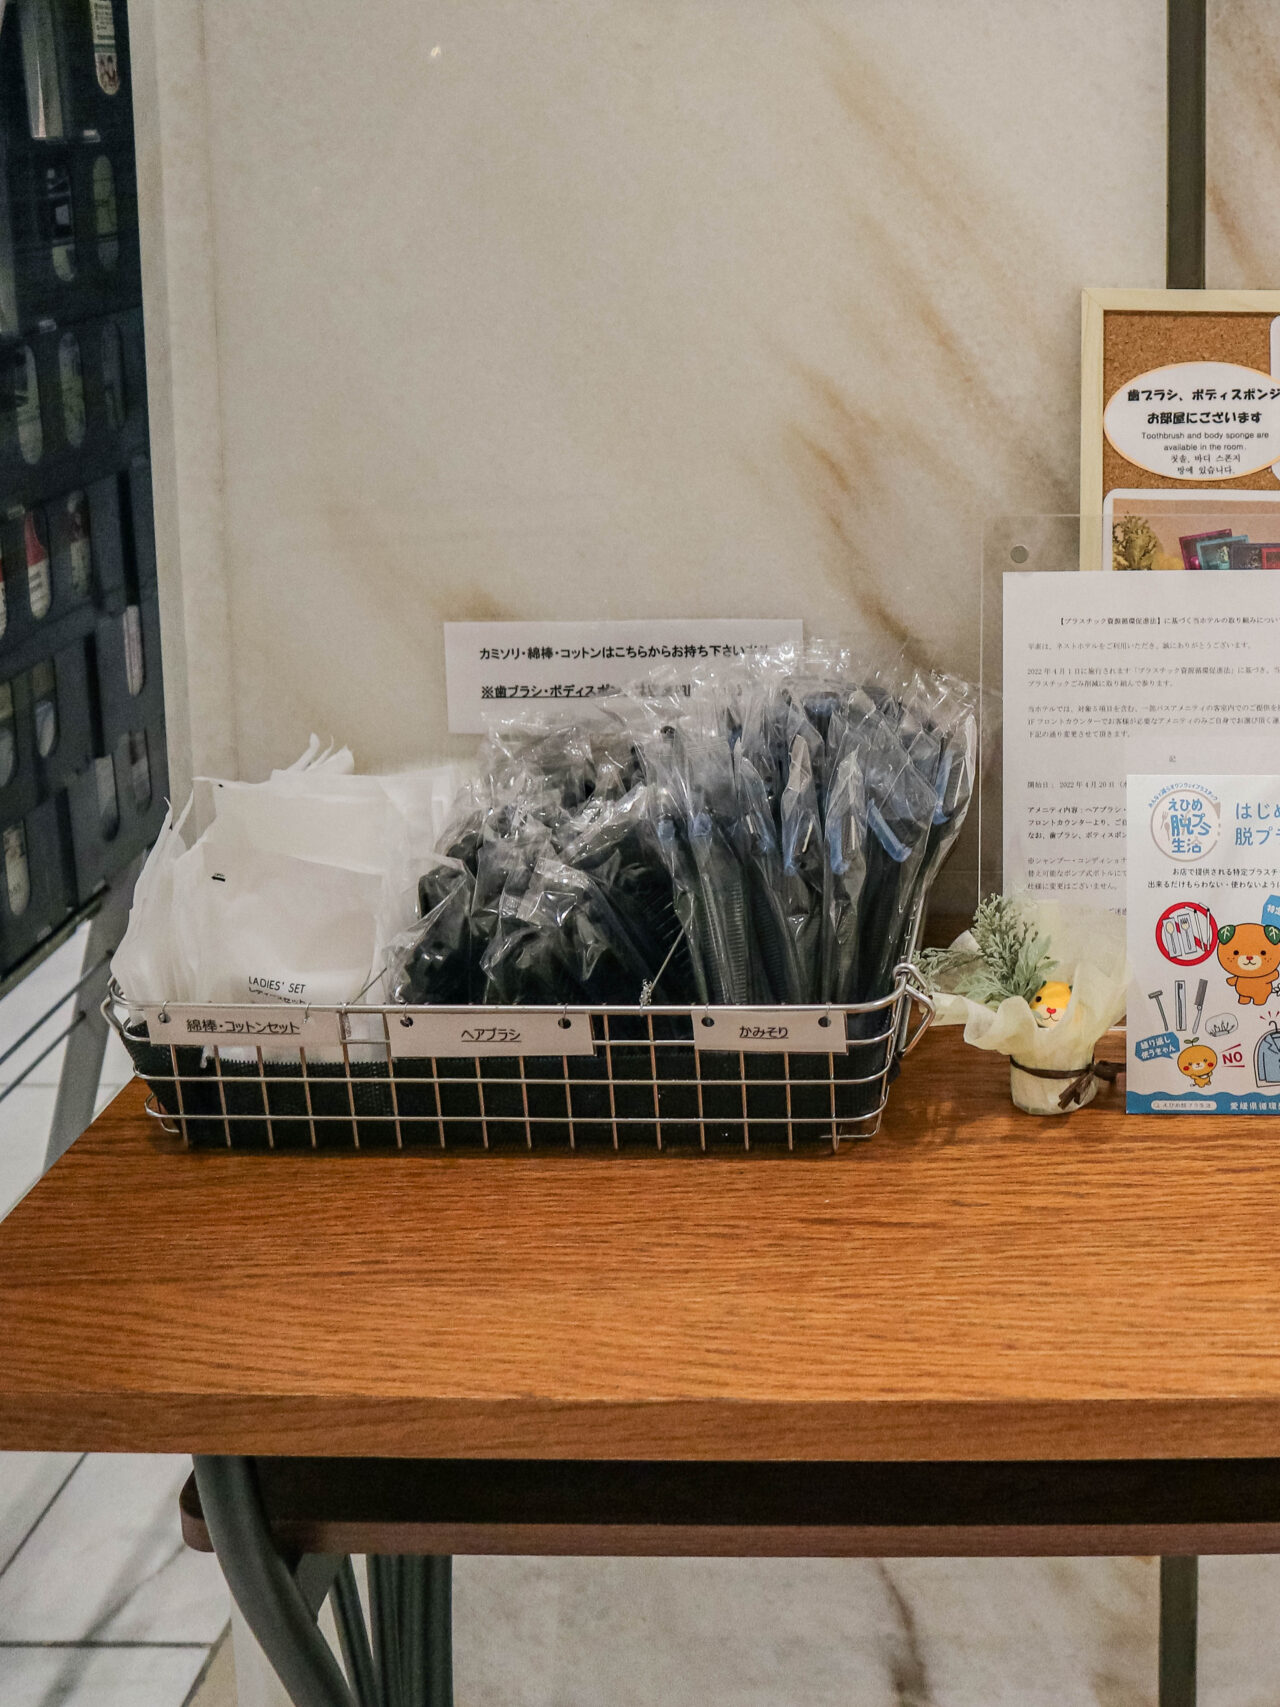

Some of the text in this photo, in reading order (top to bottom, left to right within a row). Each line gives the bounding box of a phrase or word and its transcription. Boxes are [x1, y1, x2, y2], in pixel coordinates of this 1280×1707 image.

[1147, 411, 1263, 425] お部屋にございます
[1141, 431, 1185, 440] Toothbrush
[1186, 431, 1202, 439] and
[1204, 431, 1223, 441] body
[1225, 432, 1254, 441] sponge
[1163, 443, 1198, 451] available
[1199, 443, 1207, 451] in
[1209, 443, 1222, 451] the
[1199, 465, 1235, 475] 있습니다.
[1168, 798, 1203, 812] えひめ
[1170, 813, 1212, 837] 脱プラ
[287, 982, 306, 995] SET
[186, 1018, 302, 1034] 綿棒・コットンセット
[739, 1025, 789, 1039] かみそり
[461, 1027, 522, 1041] ヘアブラシ
[1222, 1051, 1243, 1065] NO
